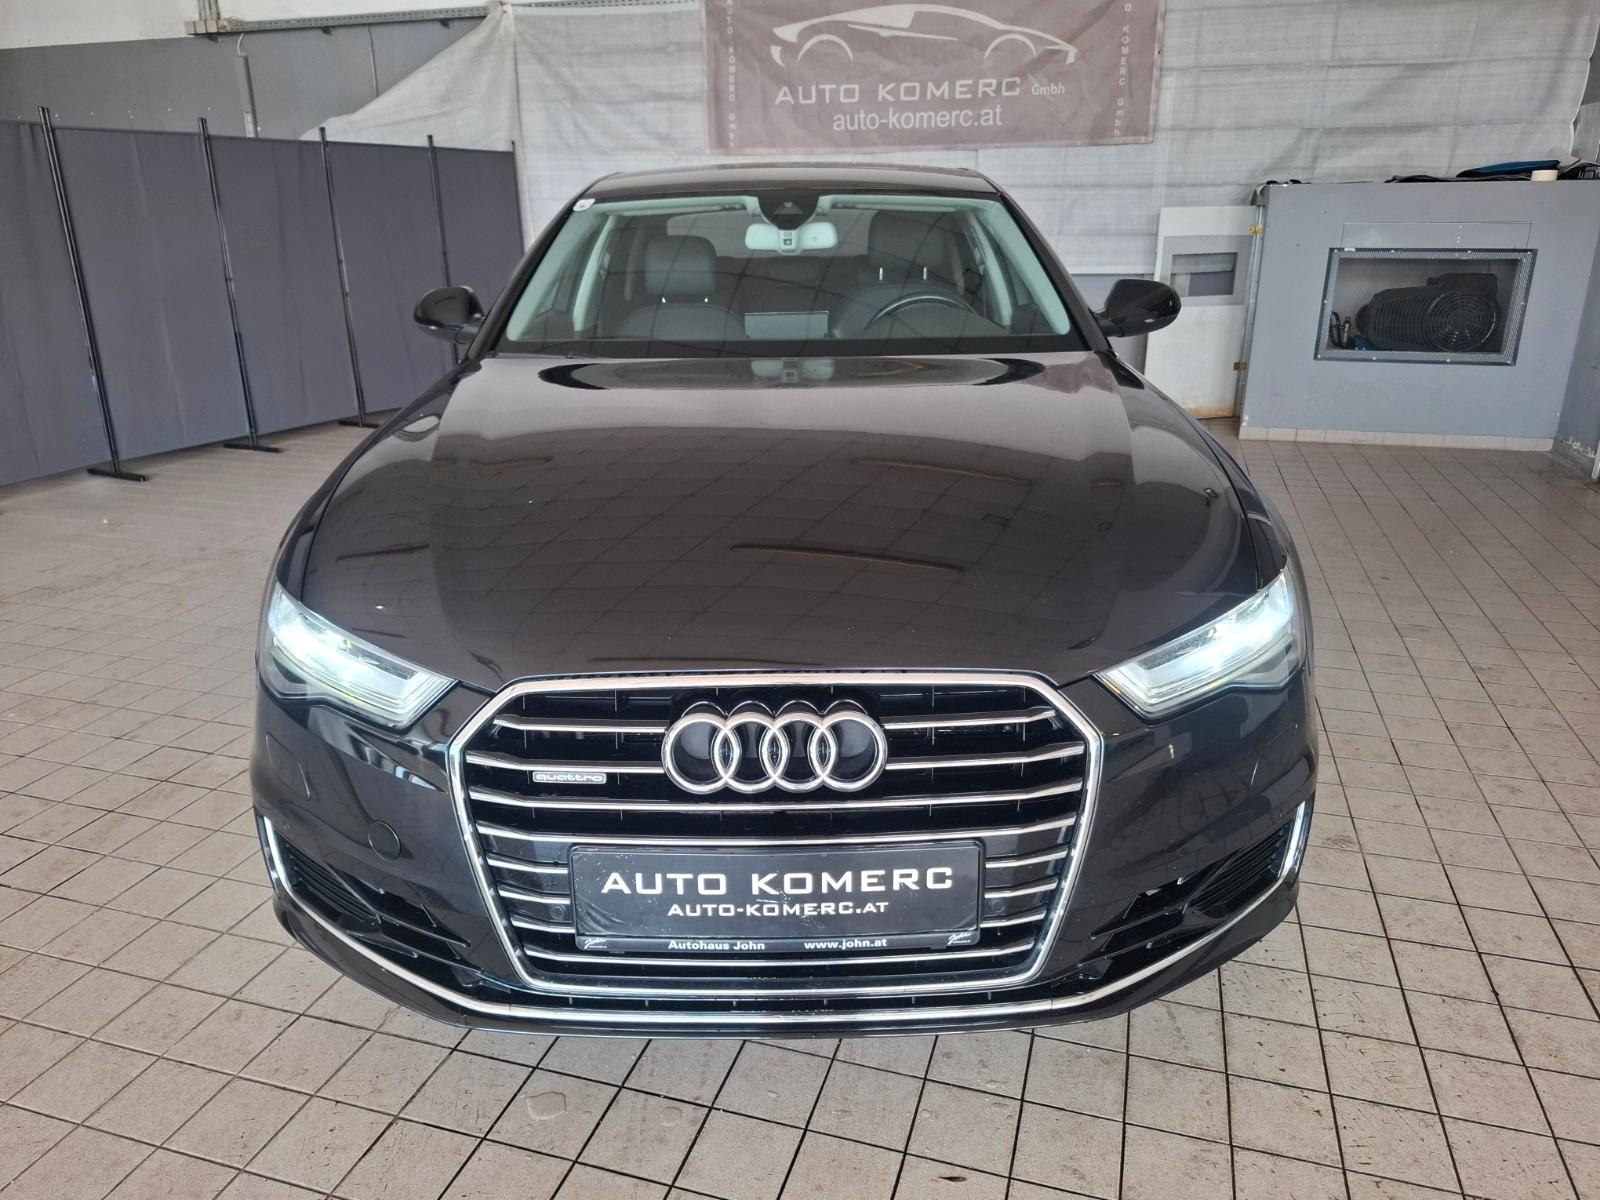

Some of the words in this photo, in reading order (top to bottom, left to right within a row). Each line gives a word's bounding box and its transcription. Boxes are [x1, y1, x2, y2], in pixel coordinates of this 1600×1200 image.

[1118, 24, 1130, 86] KOMERC
[728, 46, 736, 102] KOMERC
[775, 84, 860, 105] AUTO
[877, 77, 1021, 102] KOMERC
[1031, 84, 1066, 97] Gmbh
[832, 105, 1003, 131] auto-komerc.at
[535, 773, 603, 783] quattro
[601, 872, 727, 896] AUTO
[751, 867, 953, 895] KOMERC
[667, 901, 889, 917] AUTO-KOMERC.AT
[668, 939, 730, 952] Autohaus
[733, 940, 766, 951] John
[804, 937, 888, 950] www.john.at
